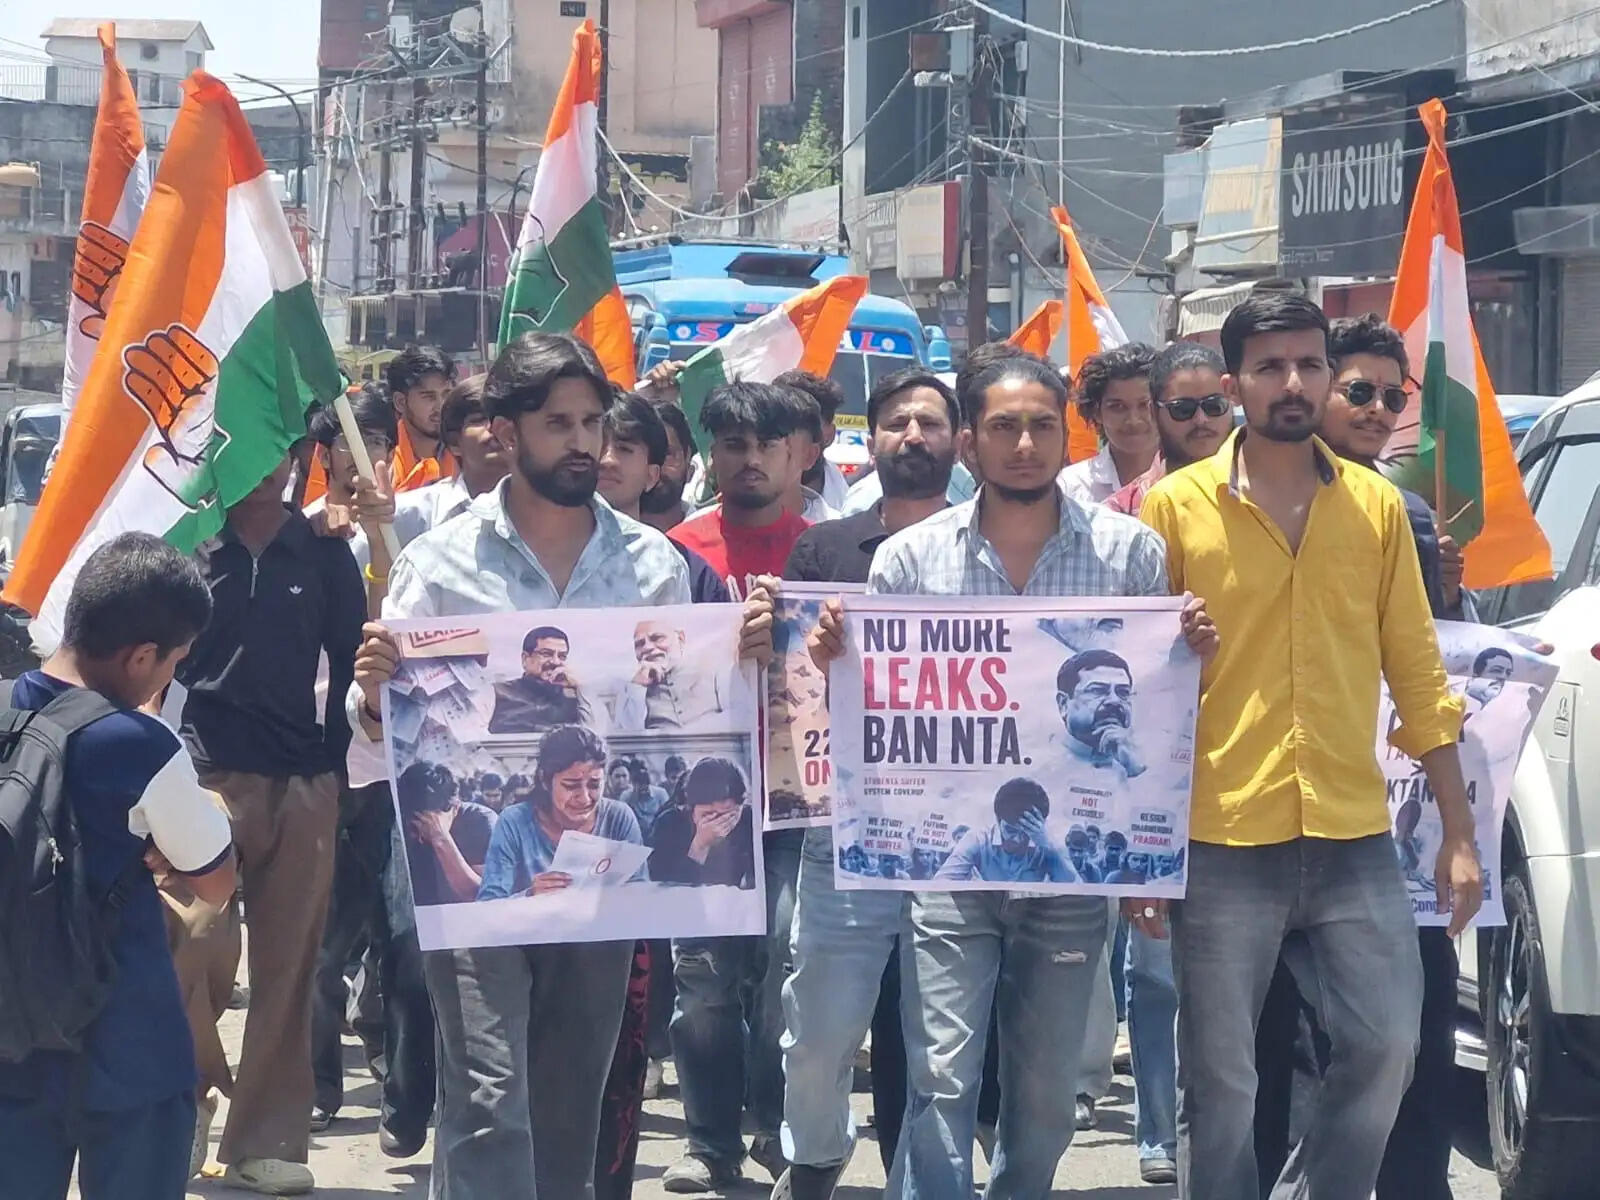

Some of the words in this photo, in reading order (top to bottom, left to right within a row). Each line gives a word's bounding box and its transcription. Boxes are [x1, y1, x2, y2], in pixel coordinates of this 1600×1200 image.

[1292, 138, 1404, 217] SAMSUNG
[863, 618, 906, 652] NO
[920, 618, 1012, 652] MORE
[864, 657, 1020, 711] LEAKS.
[863, 715, 938, 764] BAN
[950, 716, 1032, 765] NTA.
[863, 787, 891, 796] SYSTEM
[1081, 797, 1099, 808] NOT
[868, 816, 878, 826] WE
[923, 820, 948, 830] FUTURE
[866, 828, 883, 837] THEY
